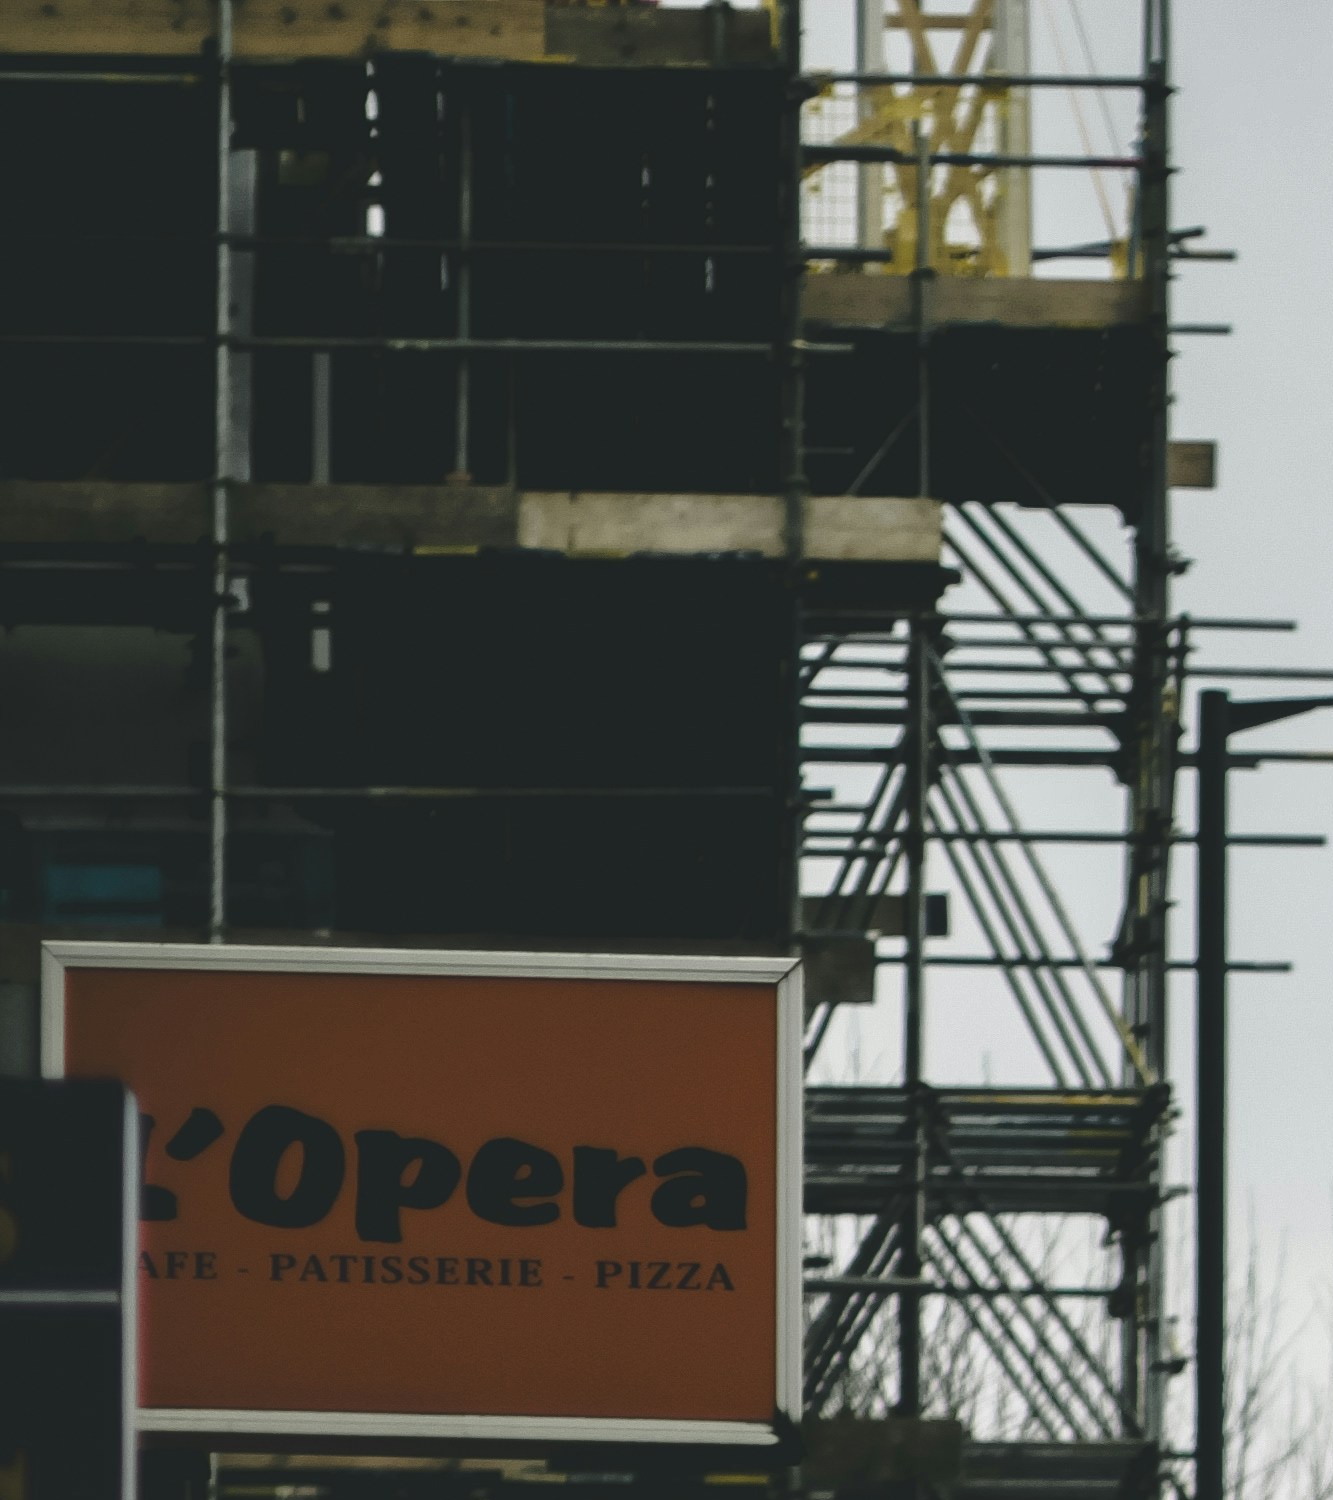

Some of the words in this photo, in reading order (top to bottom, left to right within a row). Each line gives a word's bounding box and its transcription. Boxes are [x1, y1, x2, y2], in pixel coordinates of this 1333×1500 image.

[138, 1251, 219, 1281] AFE
[269, 1253, 544, 1288] PATISSERIE
[594, 1259, 735, 1292] PIZZA
